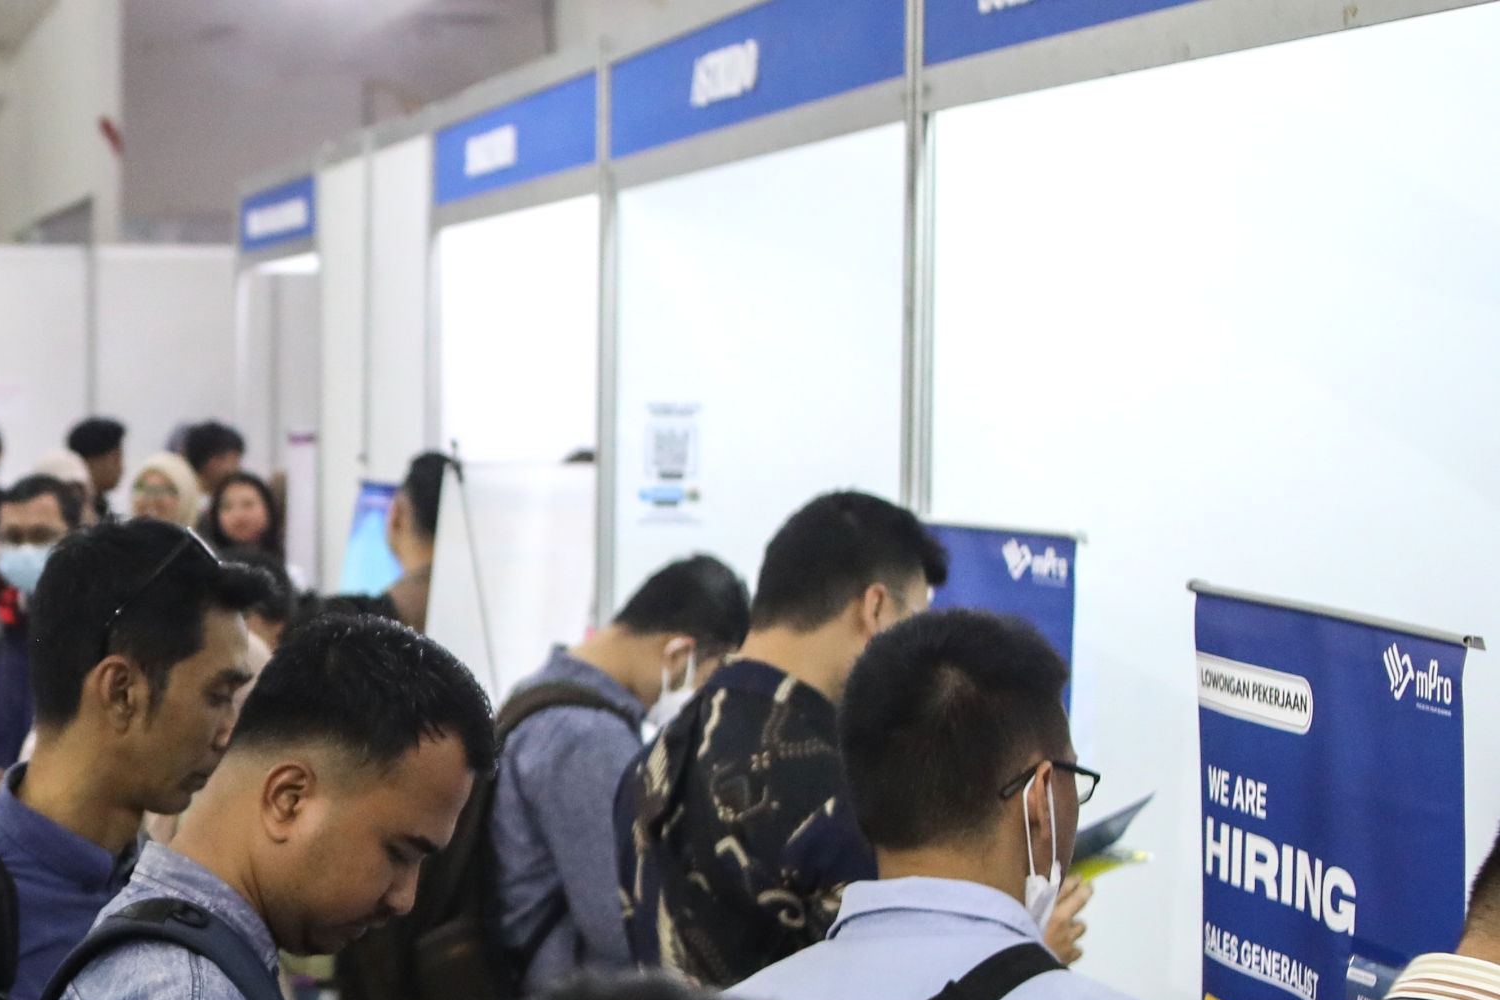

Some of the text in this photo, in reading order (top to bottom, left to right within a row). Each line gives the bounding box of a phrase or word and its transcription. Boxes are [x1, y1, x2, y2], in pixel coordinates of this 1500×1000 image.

[1201, 667, 1308, 713] LOWONGAN PEKERJAAN
[1416, 659, 1452, 705] mPro
[1208, 764, 1267, 820] WE ARE
[1205, 815, 1357, 937] HIRING
[1204, 922, 1320, 1000] SALES GENERALIST
